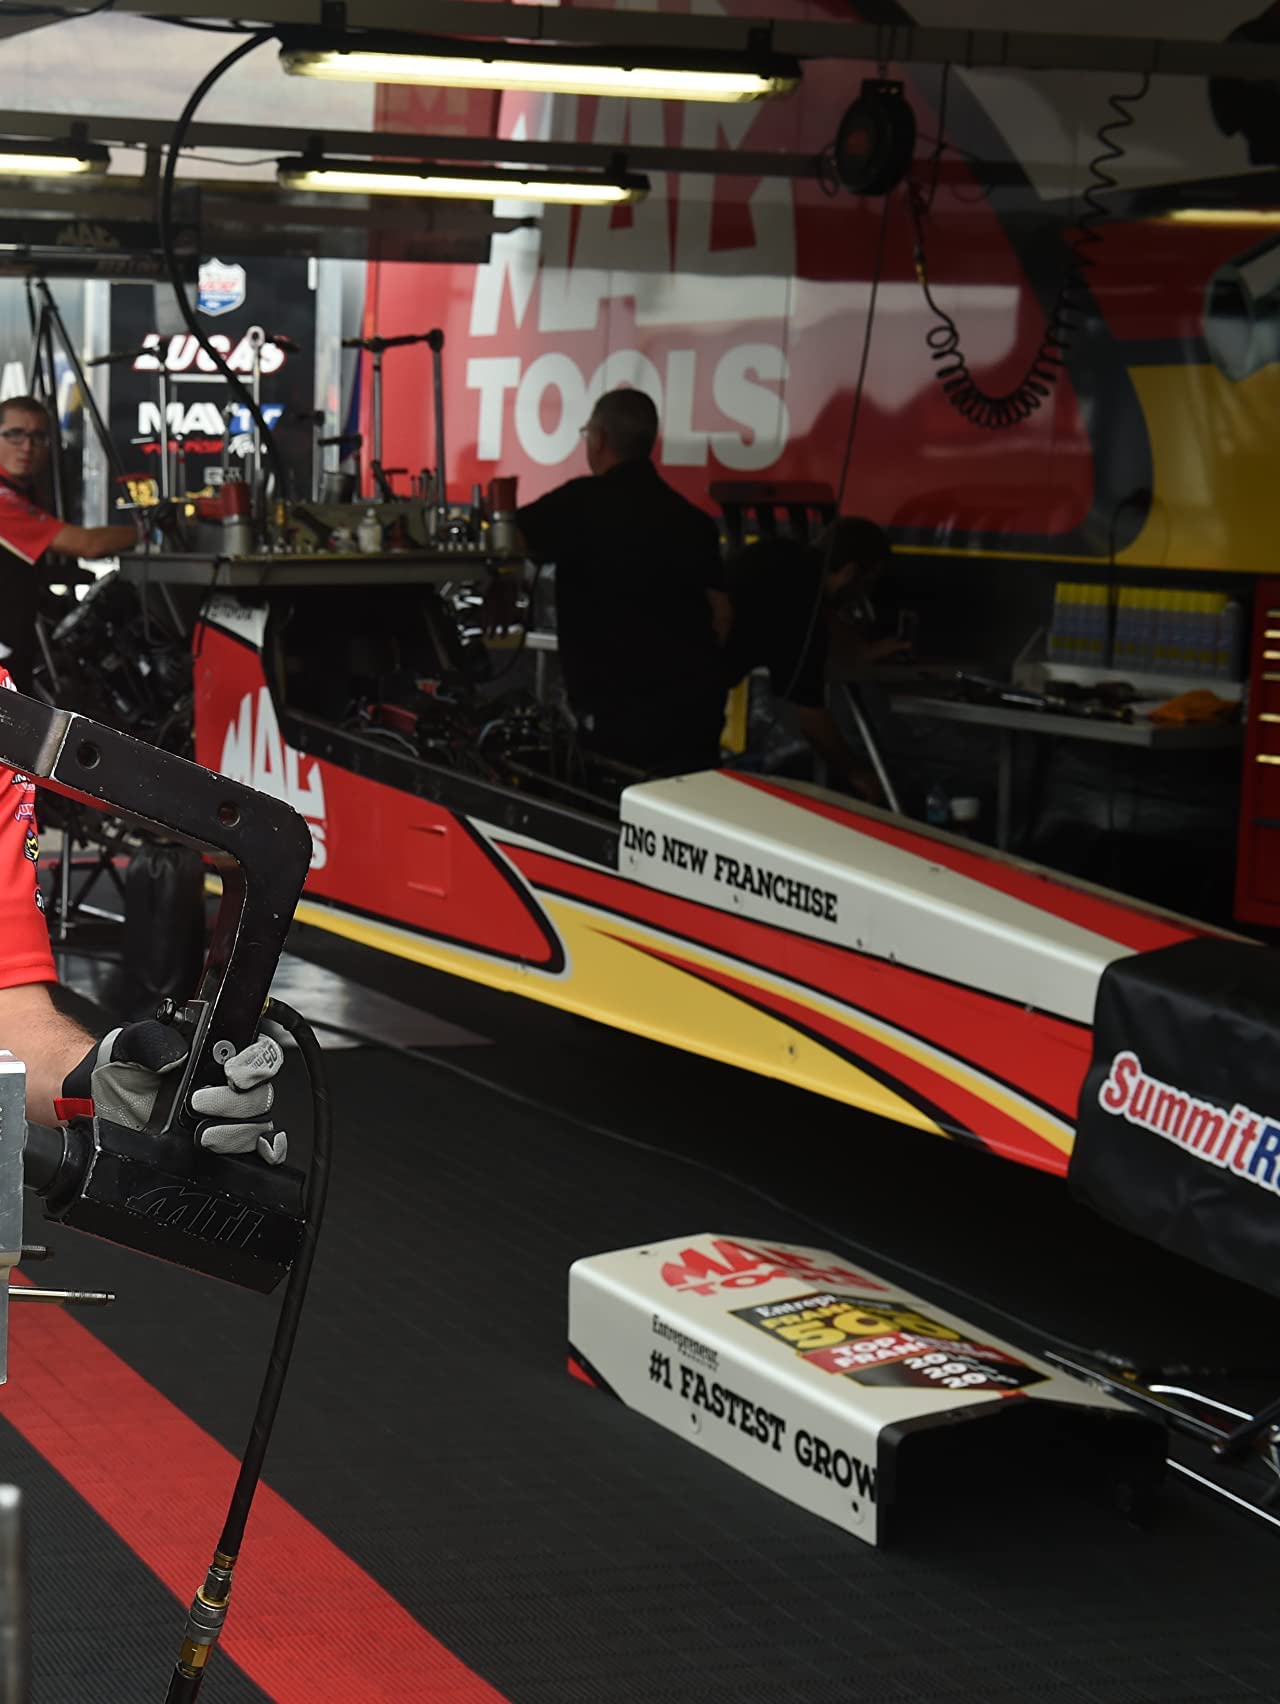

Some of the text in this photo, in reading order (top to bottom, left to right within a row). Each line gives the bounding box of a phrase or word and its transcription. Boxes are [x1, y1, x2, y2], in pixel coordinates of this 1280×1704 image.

[132, 333, 290, 374] LUCAS
[466, 343, 790, 470] TOOLS
[621, 822, 838, 923] ING NEW FRANCHISE
[1100, 1053, 1280, 1193] SummitR
[649, 1350, 877, 1503] #1 FASTEST GROW
